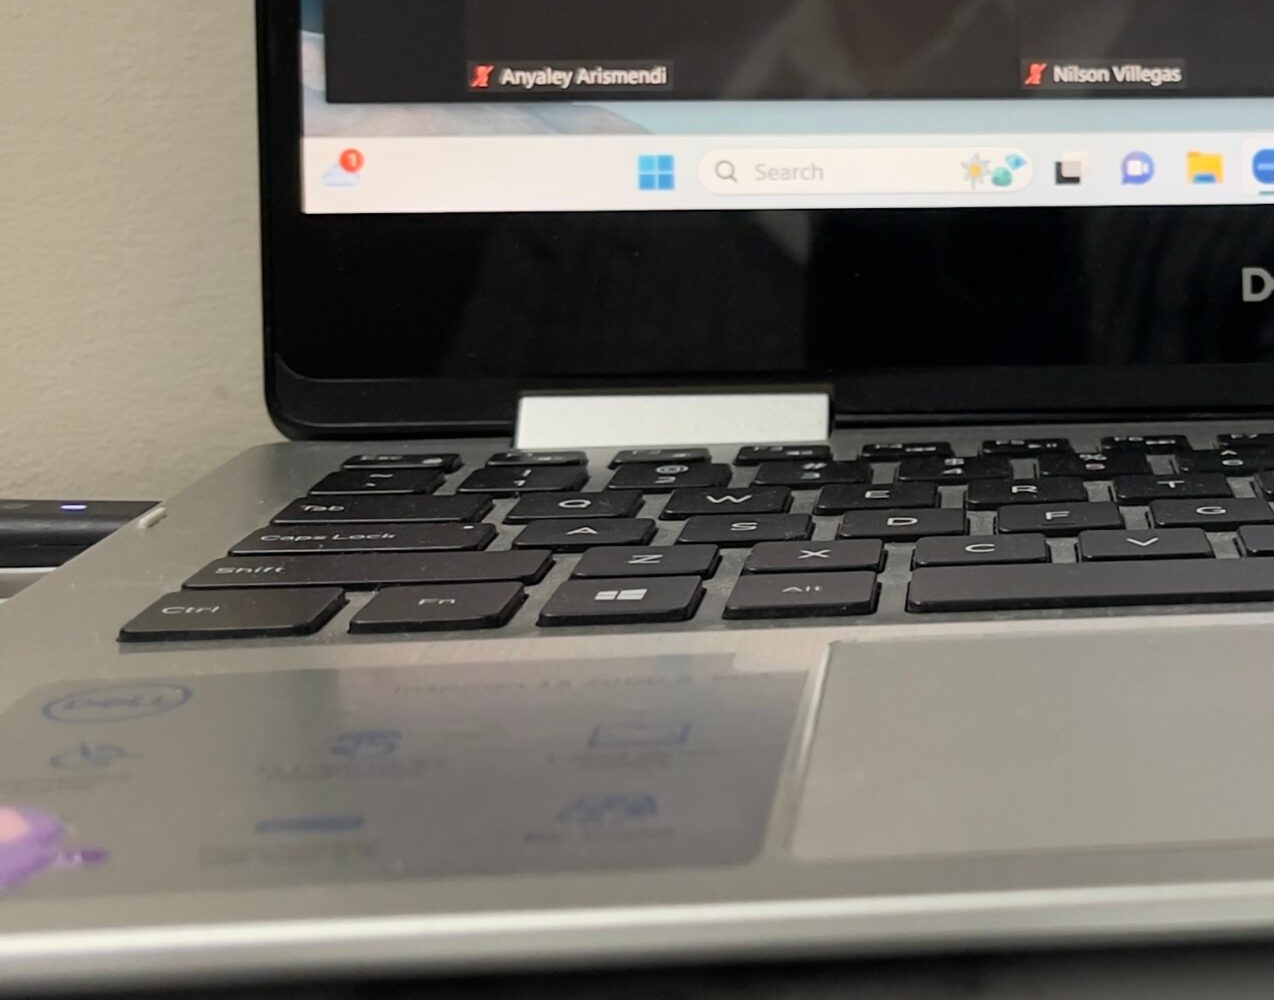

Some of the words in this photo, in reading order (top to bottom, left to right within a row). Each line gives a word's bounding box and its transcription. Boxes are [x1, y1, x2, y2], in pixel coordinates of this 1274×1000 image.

[501, 67, 573, 89] Anyaley
[576, 65, 667, 87] Arismendi
[1053, 64, 1110, 83] Nilson
[1112, 64, 1182, 87] Villegas
[754, 162, 824, 182] Search
[706, 494, 752, 504] W
[566, 526, 599, 536] A
[730, 521, 758, 532] S
[260, 533, 326, 543] Caps
[332, 533, 399, 542] Lock
[1125, 536, 1160, 547] V
[797, 547, 832, 559] X
[214, 565, 287, 575] Shift
[782, 584, 824, 594] Alt
[161, 605, 223, 616] Ctrl
